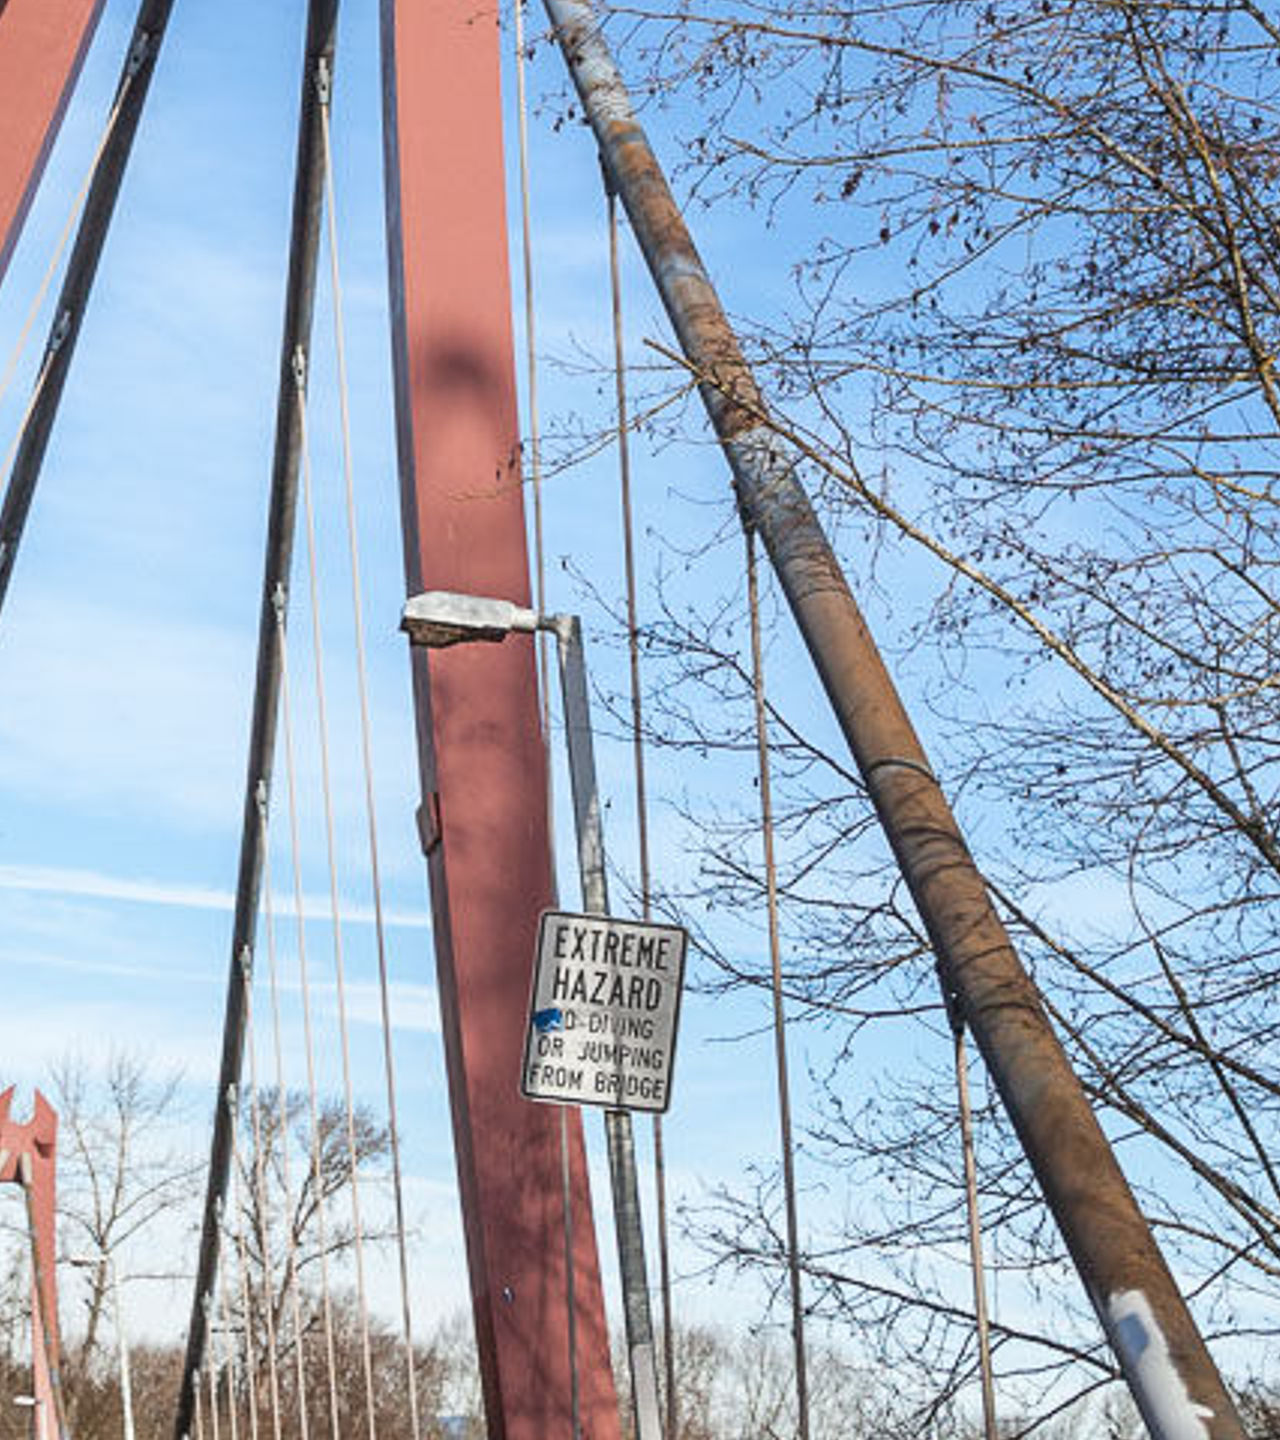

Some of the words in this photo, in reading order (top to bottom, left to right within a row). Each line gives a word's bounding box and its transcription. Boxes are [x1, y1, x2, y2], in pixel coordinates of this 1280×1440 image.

[553, 926, 670, 970] EXTREME
[552, 967, 662, 1010] HAZARD
[588, 1013, 654, 1039] DIVING
[537, 1035, 564, 1058] OR
[577, 1039, 664, 1069] JUMPING
[529, 1065, 583, 1091] FROM
[594, 1071, 665, 1101] BRIDGE
